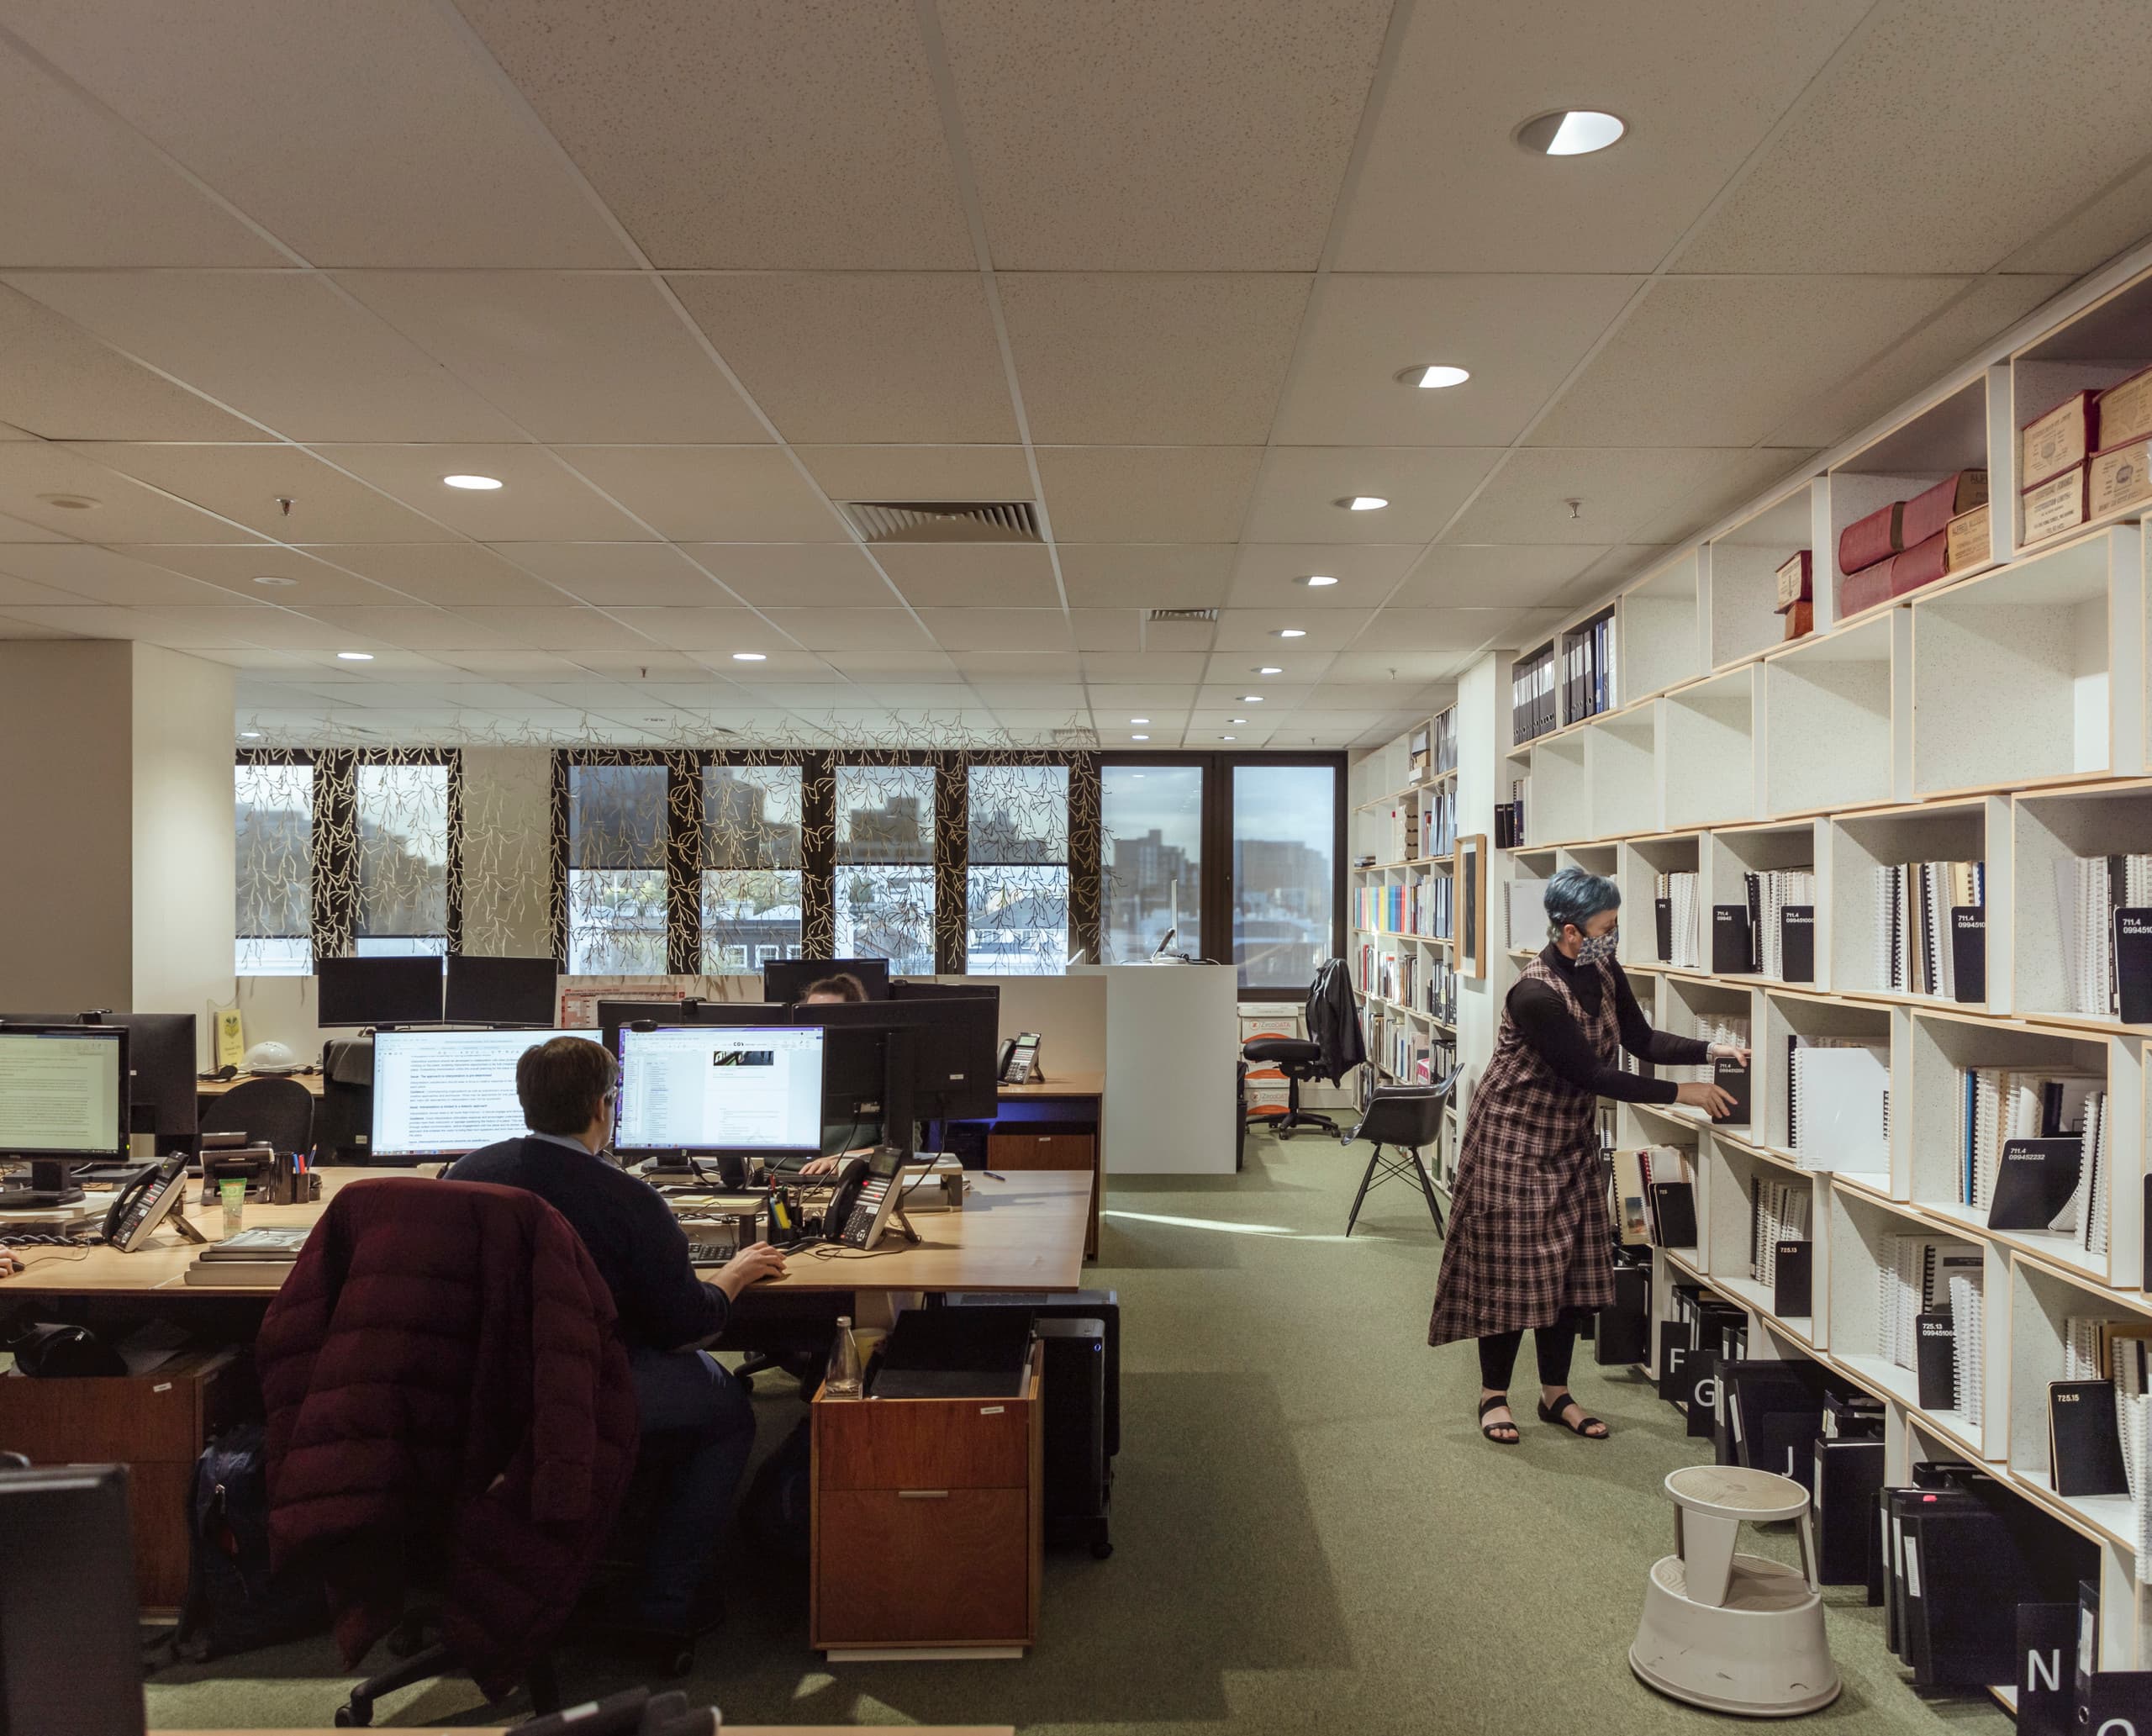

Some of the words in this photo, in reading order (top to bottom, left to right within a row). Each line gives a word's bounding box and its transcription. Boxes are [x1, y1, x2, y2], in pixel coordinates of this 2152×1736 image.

[1670, 1348, 1685, 1373] F
[1694, 1379, 1715, 1406] G
[2057, 1394, 2080, 1402] 725.15
[1781, 1446, 1793, 1478] J
[2028, 1649, 2060, 1691] N
